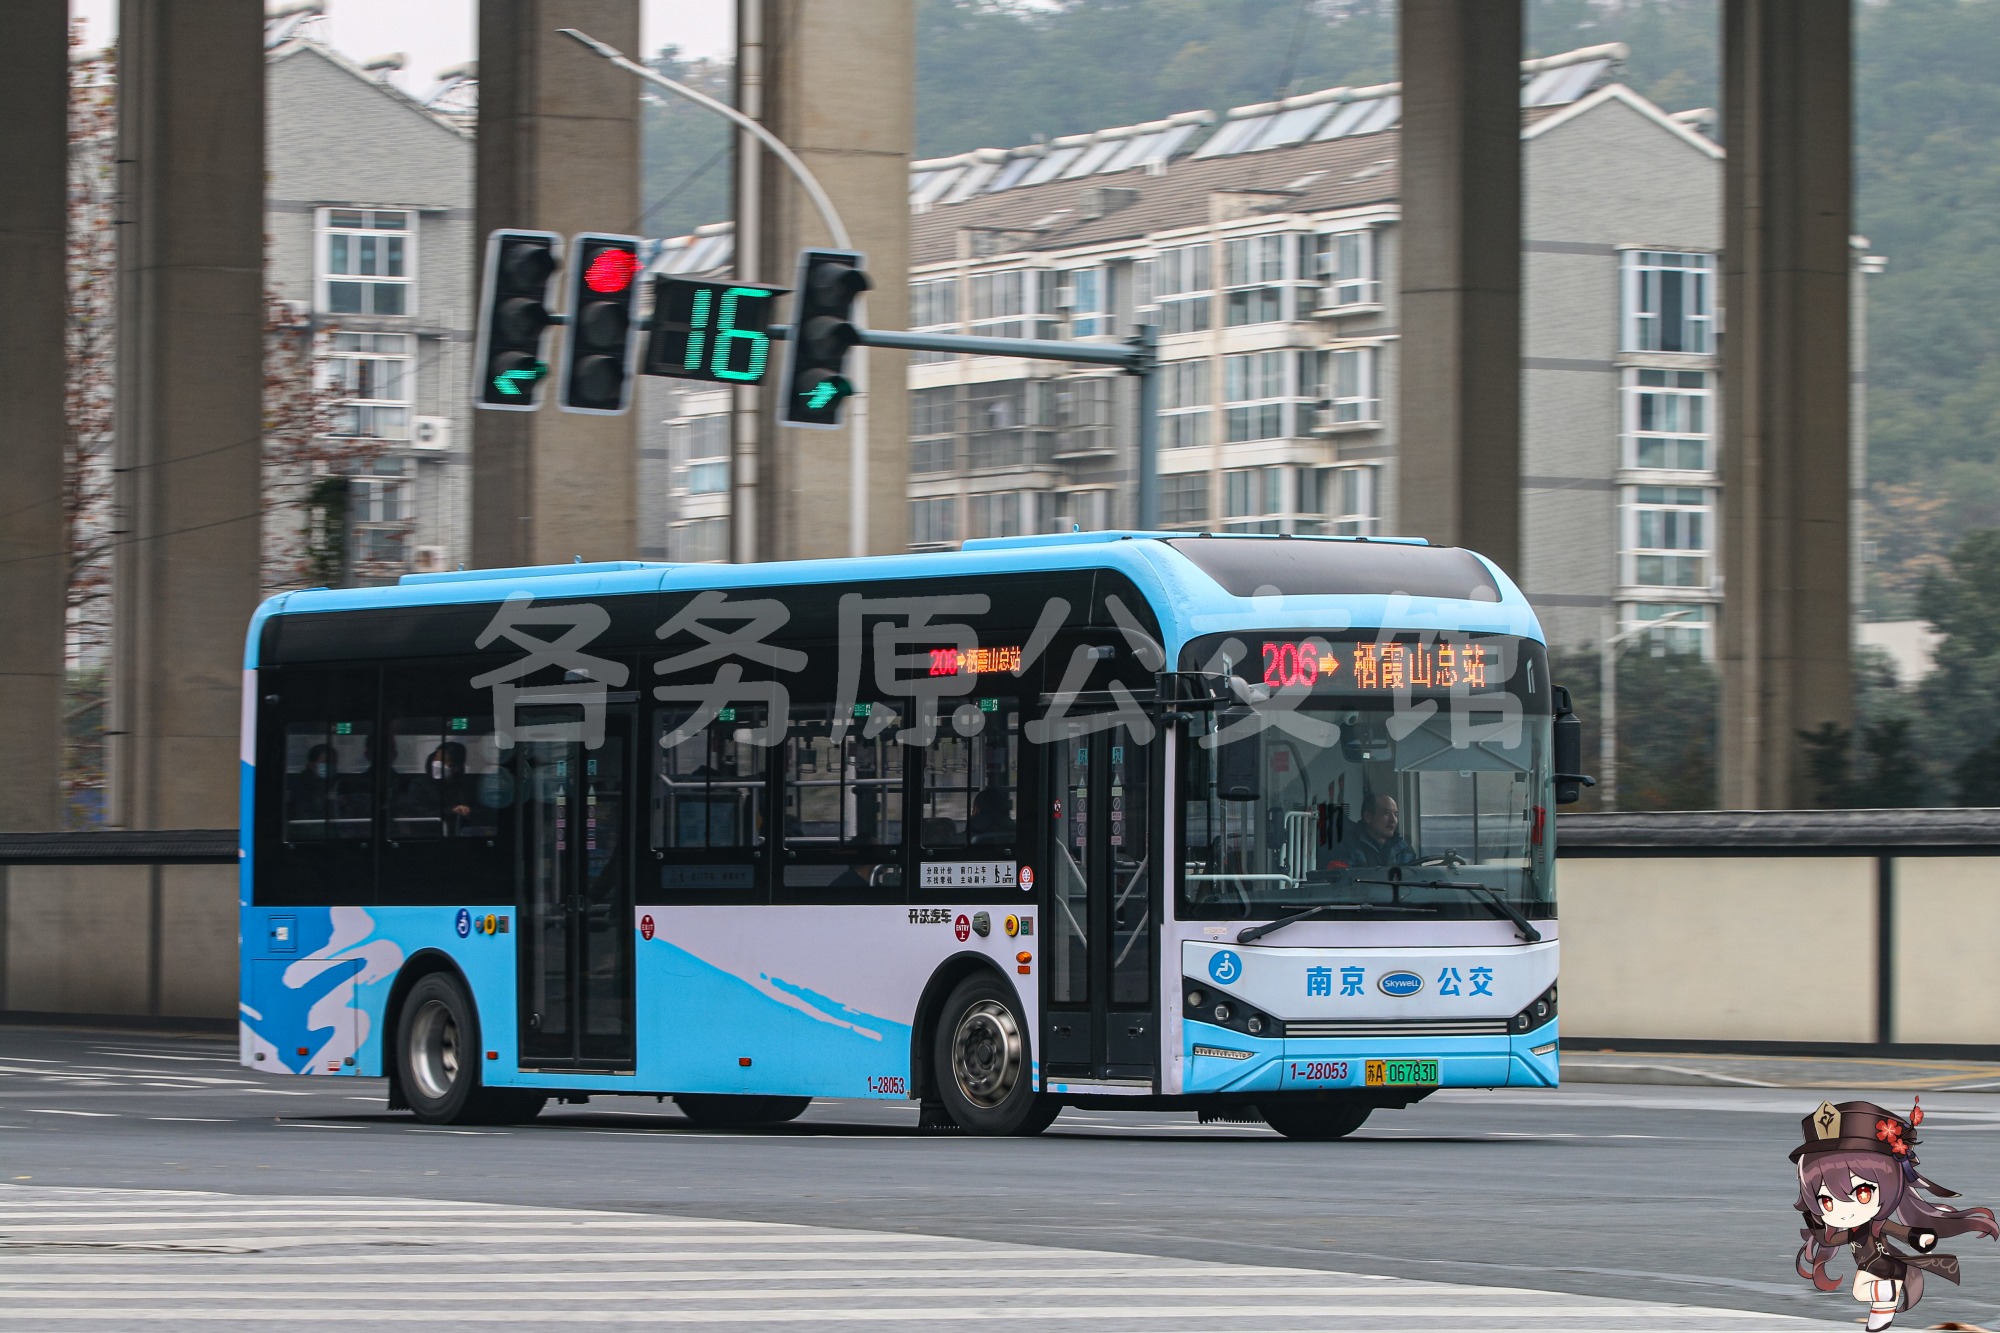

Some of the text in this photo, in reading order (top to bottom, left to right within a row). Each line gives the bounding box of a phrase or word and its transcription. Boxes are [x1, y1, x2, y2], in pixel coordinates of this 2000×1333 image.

[684, 286, 773, 380] 16
[930, 646, 1021, 675] 206 栖霞山总站
[1262, 641, 1486, 689] 206 栖霞山总站
[1004, 865, 1012, 876] 上
[955, 924, 970, 932] ENTRY
[1306, 966, 1366, 997] 南京
[1437, 966, 1494, 997] 公交
[1290, 1062, 1348, 1080] 1-28053
[867, 1075, 905, 1095] 1-28053
